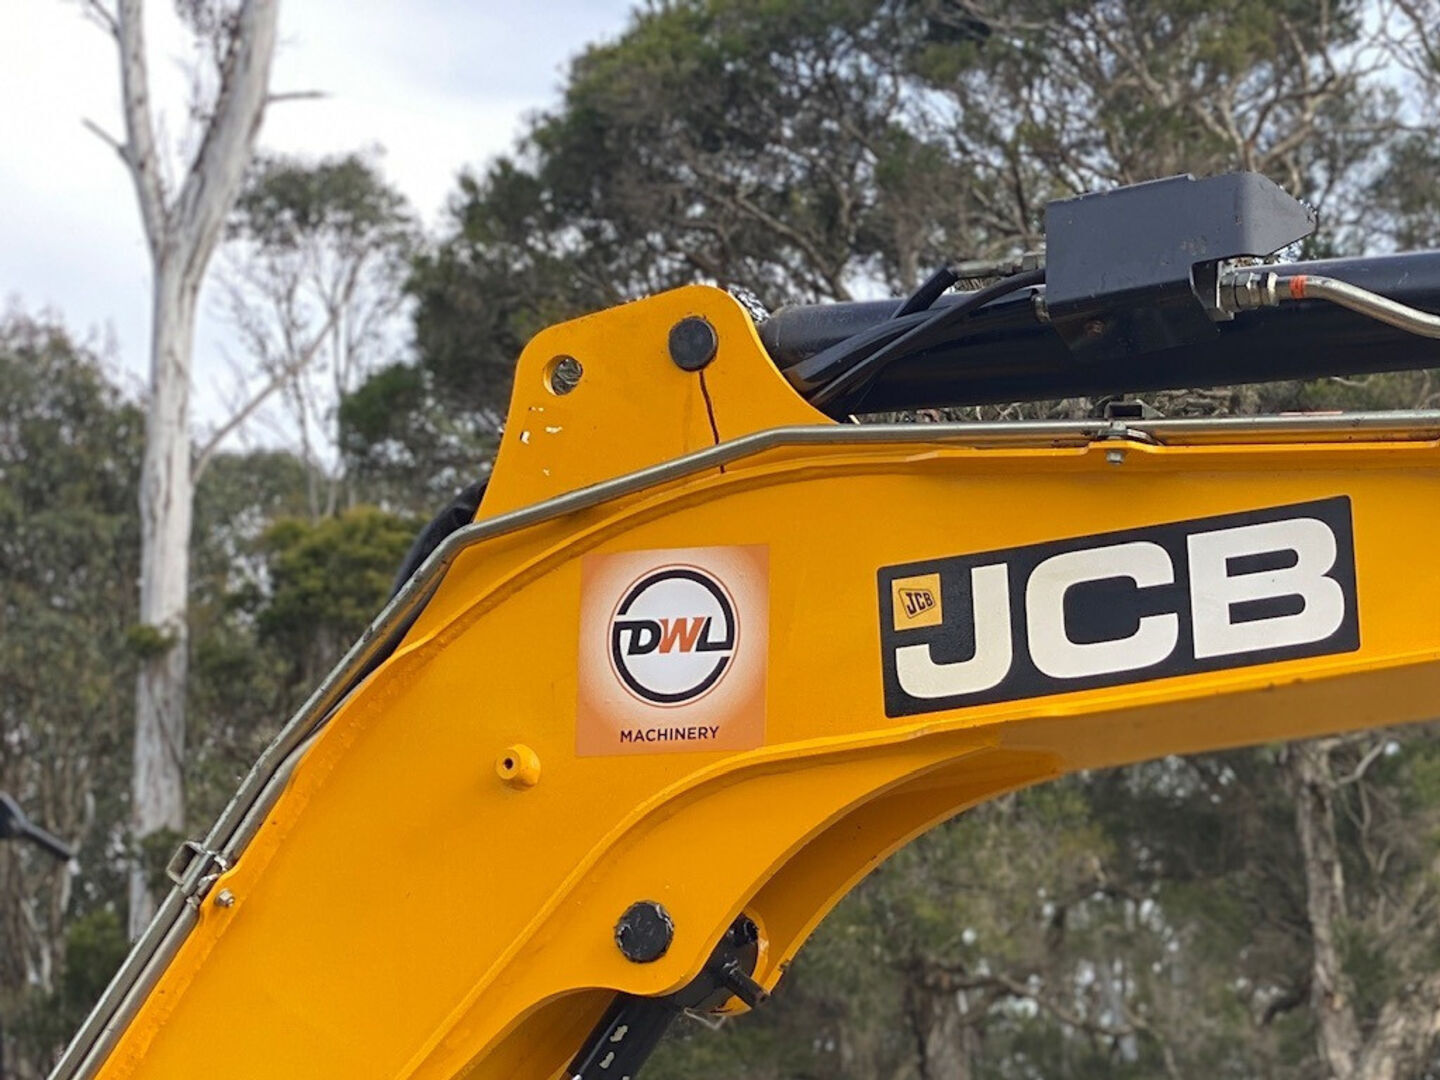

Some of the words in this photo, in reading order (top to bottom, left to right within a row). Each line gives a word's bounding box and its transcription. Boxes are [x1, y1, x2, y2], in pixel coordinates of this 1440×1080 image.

[896, 518, 1345, 699] JCB
[905, 591, 933, 615] JCB
[612, 616, 734, 656] DWL
[619, 725, 721, 743] MACHINERY
